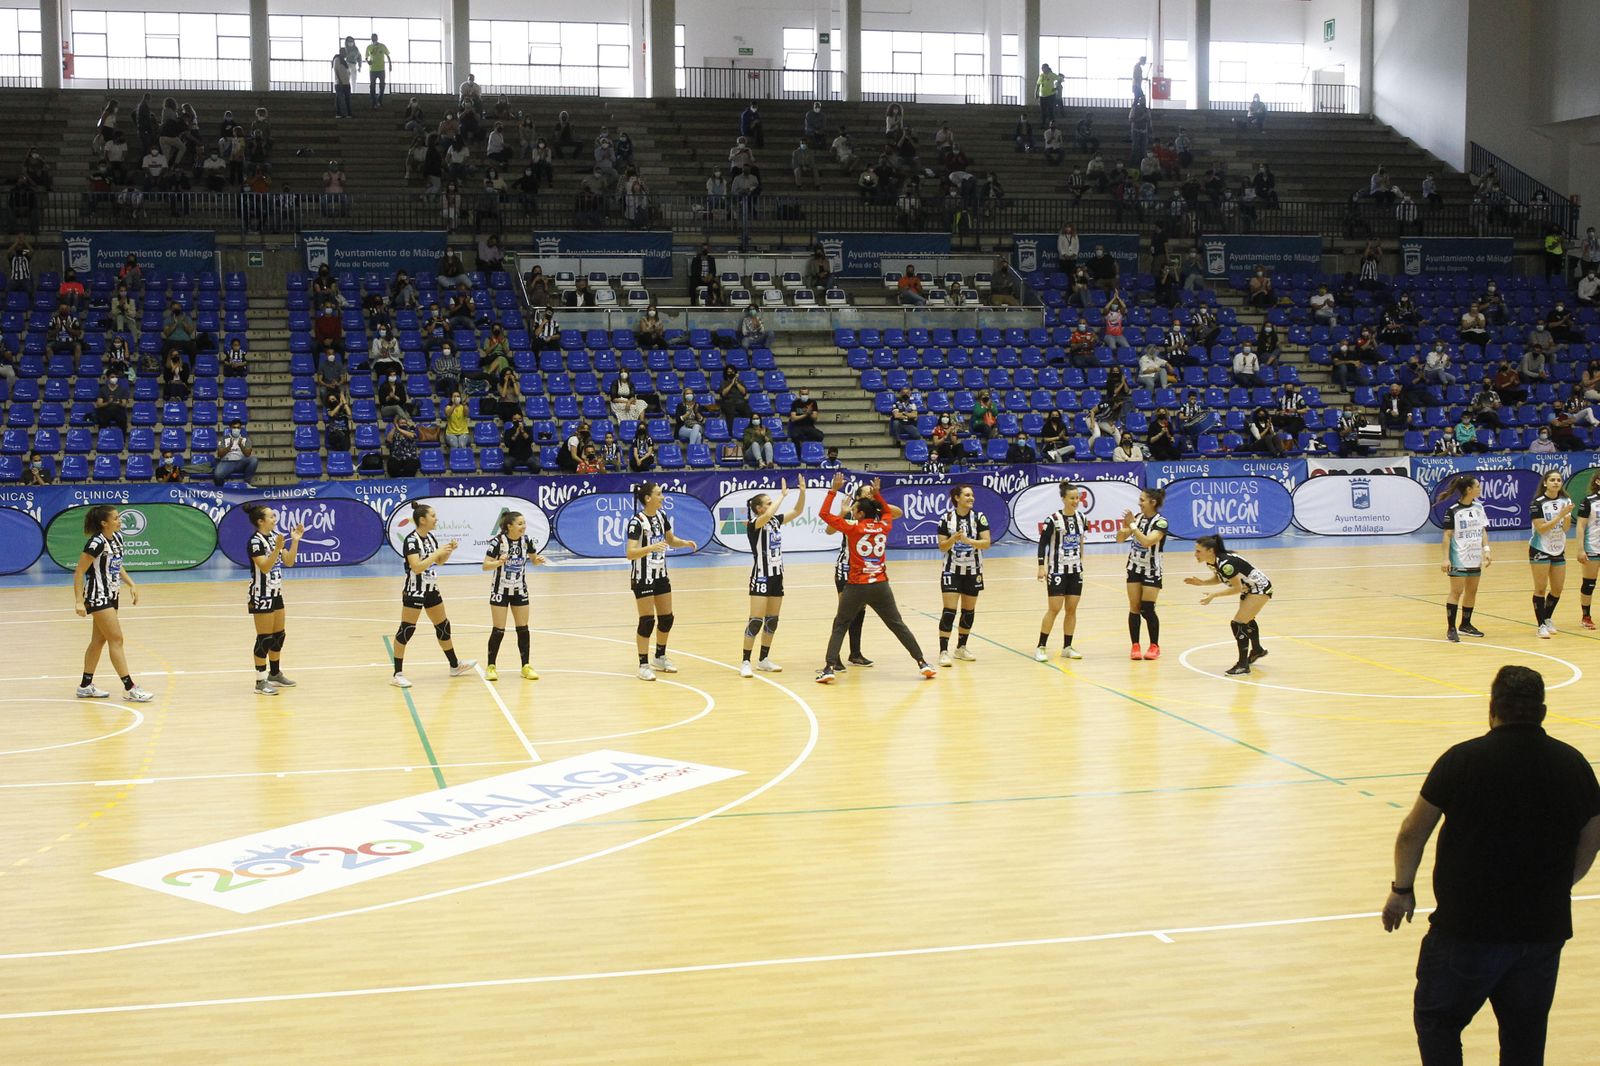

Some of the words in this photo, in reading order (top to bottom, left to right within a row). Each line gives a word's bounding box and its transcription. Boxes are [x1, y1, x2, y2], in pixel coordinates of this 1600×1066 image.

[97, 249, 163, 260] Ayuntamiento
[166, 249, 176, 258] de
[179, 248, 213, 259] Málaga
[334, 248, 397, 259] Ayuntamiento
[400, 249, 410, 257] de
[413, 248, 445, 259] Málaga
[1230, 253, 1282, 263] Ayuntamiento
[1294, 253, 1320, 263] Málaga
[1425, 254, 1475, 263] Ayuntamiento
[1487, 254, 1512, 264] Málaga
[363, 260, 389, 269] Deporte
[1162, 464, 1210, 474] CLINICAS
[1243, 462, 1290, 472] CLINICAS
[356, 485, 408, 495] CLINICAS
[1190, 480, 1258, 495] CLINICAS
[74, 490, 130, 500] CLINICAS
[170, 489, 224, 499] CLINICAS
[263, 488, 316, 498] CLINICAS
[1334, 514, 1390, 524] Ayuntamiento
[1218, 525, 1259, 534] DENTAL
[1354, 524, 1384, 533] Málaga
[856, 534, 887, 557] 68
[510, 547, 521, 556] 20
[943, 576, 952, 586] 11
[1054, 576, 1061, 585] 9
[756, 582, 767, 593] 18
[491, 593, 502, 602] 20
[260, 598, 272, 610] 27
[384, 762, 675, 834] MÁLAGA
[434, 808, 544, 840] EUROPEAN
[546, 787, 618, 810] CAPITAL
[618, 778, 647, 790] OF
[643, 766, 701, 784] SPORT
[162, 839, 424, 893] 2020
